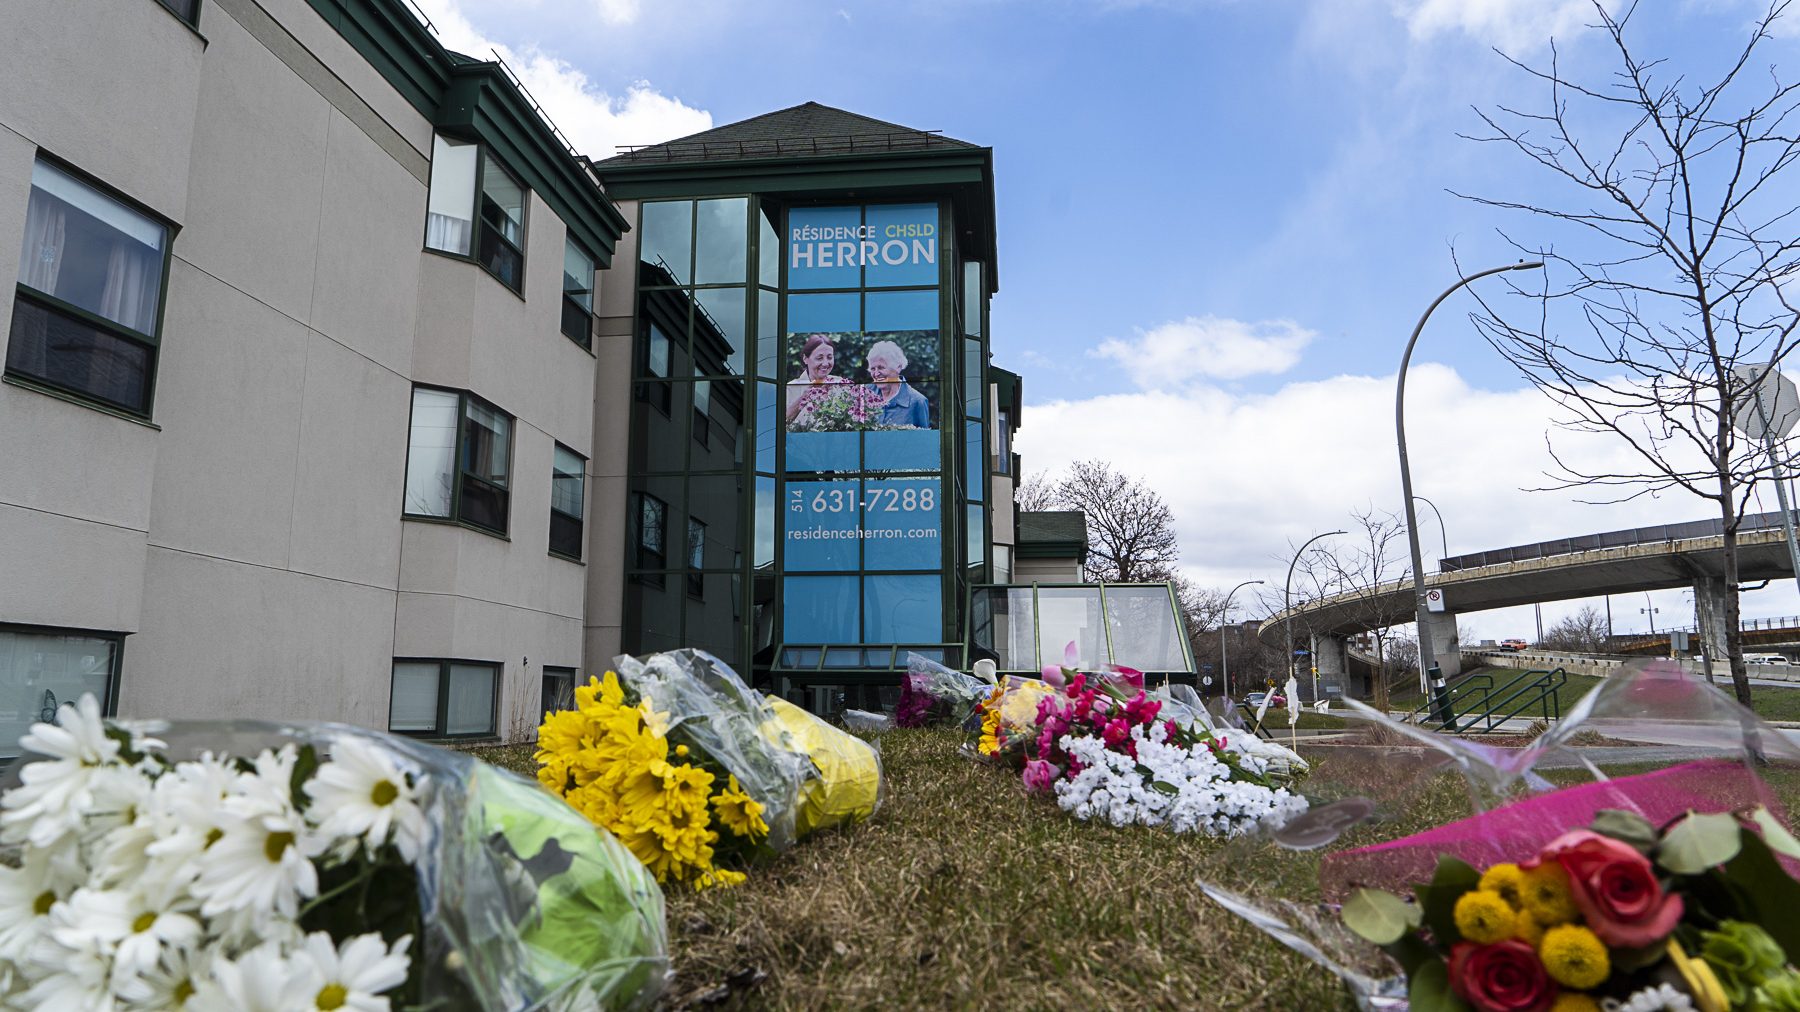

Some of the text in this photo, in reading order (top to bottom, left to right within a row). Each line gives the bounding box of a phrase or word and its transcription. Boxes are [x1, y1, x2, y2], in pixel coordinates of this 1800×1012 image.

[793, 223, 935, 241] RÉSIDENCE CHSLD
[792, 238, 935, 269] HERRON
[791, 487, 935, 513] 514 631-7288
[788, 524, 937, 540] residenceherron.com
